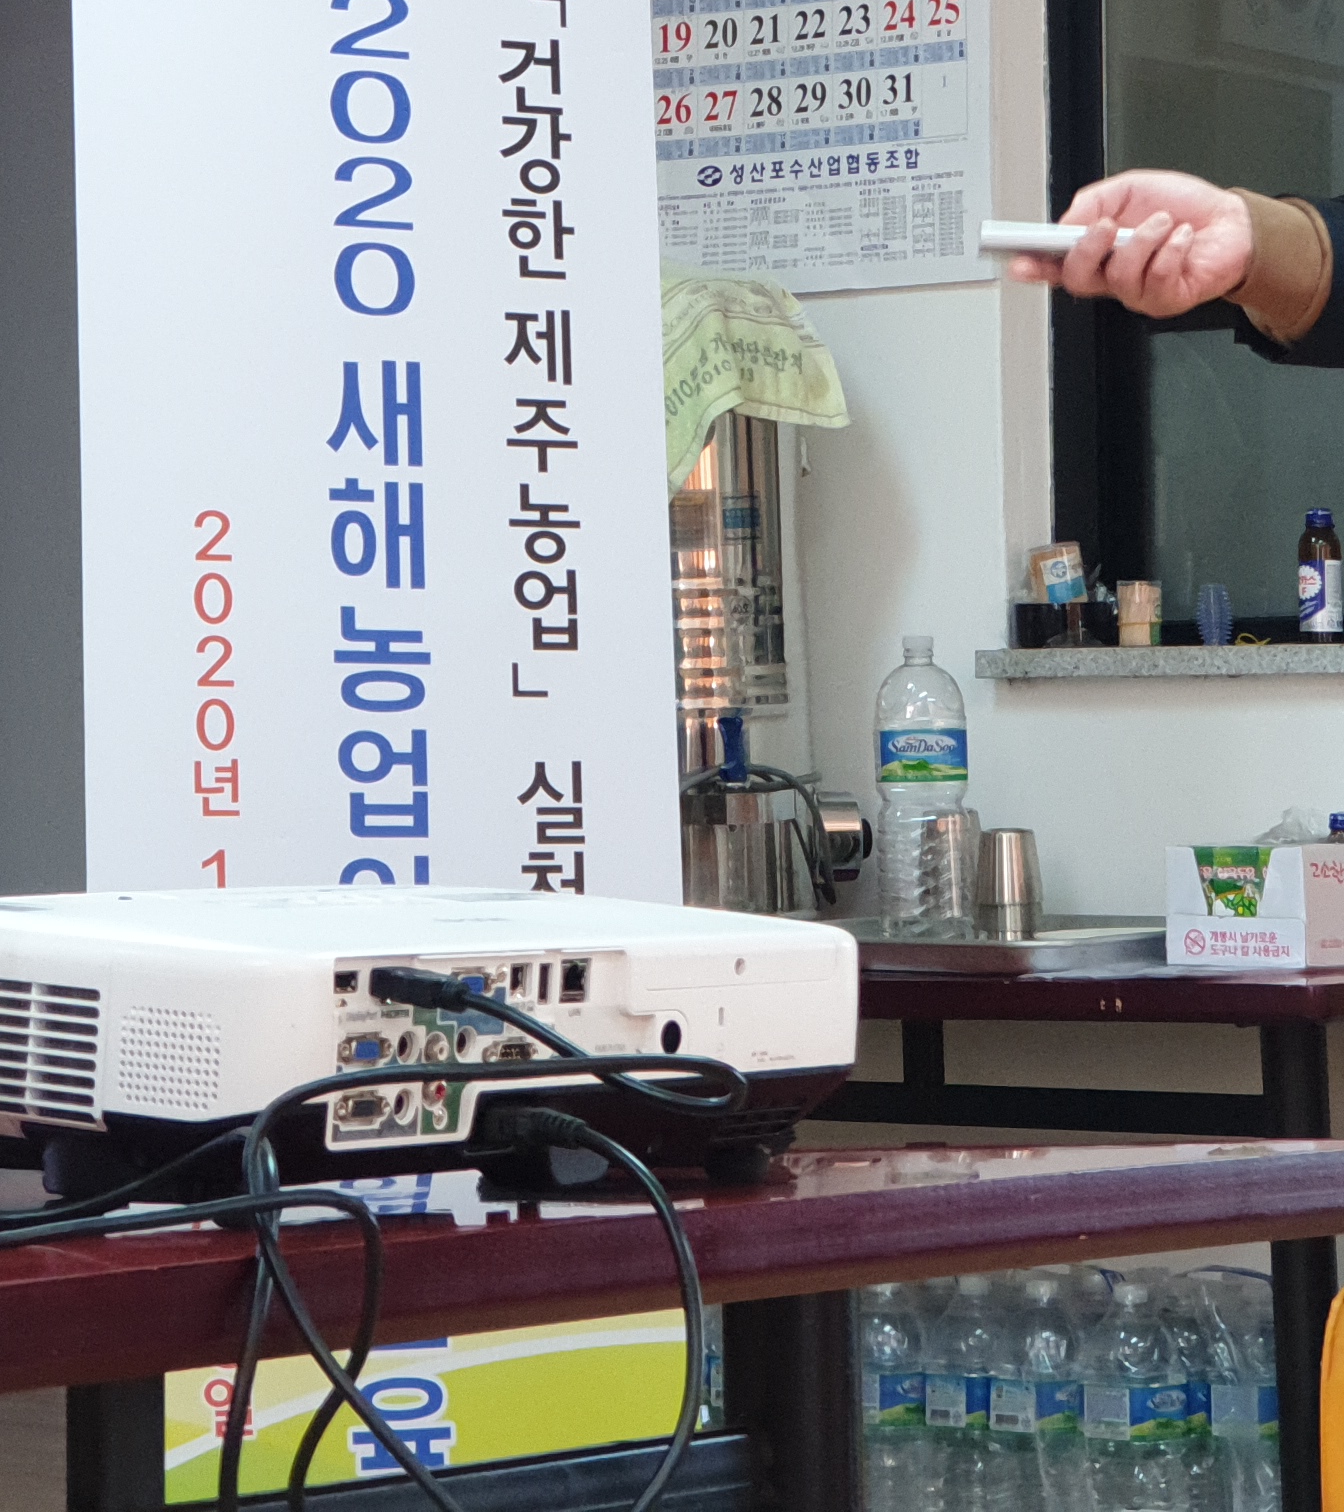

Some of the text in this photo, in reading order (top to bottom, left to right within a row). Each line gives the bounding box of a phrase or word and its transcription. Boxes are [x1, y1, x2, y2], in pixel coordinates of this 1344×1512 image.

[658, 21, 692, 54] 19
[704, 17, 738, 50] 20
[749, 14, 781, 46] 21
[794, 9, 826, 41] 22
[838, 4, 871, 36] 23
[656, 93, 692, 125] 26
[704, 90, 738, 122] 27
[749, 86, 783, 118] 28
[794, 81, 827, 113] 29
[838, 77, 872, 110] 30
[882, 72, 914, 104] 31
[729, 148, 920, 185] 성산포수산업협동조합
[193, 509, 240, 818] 2020년
